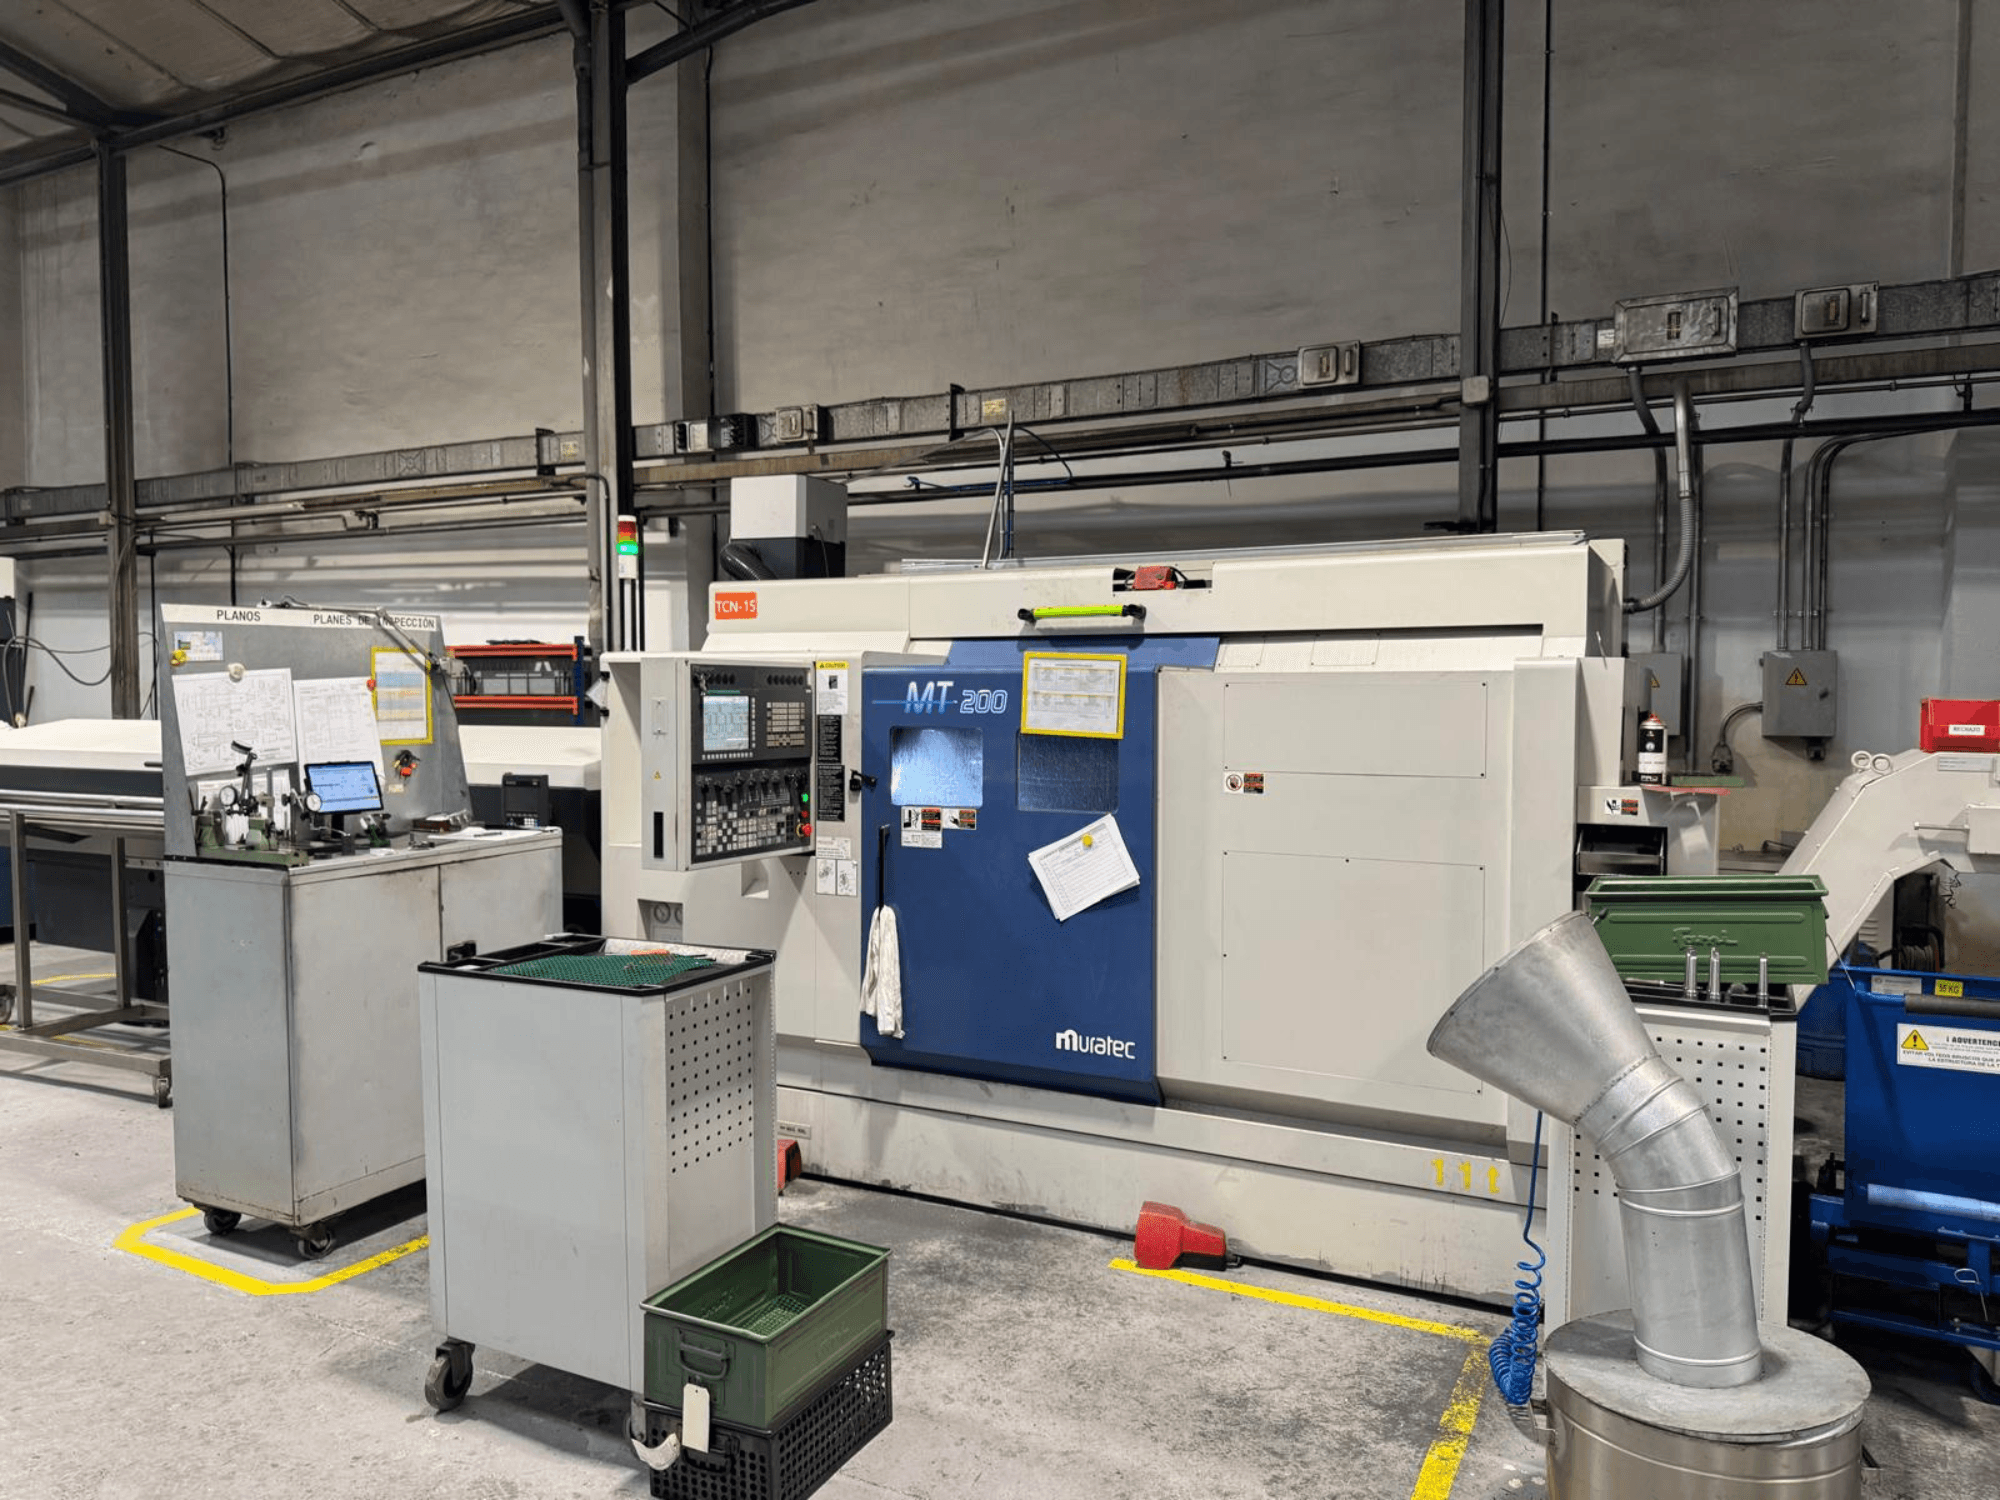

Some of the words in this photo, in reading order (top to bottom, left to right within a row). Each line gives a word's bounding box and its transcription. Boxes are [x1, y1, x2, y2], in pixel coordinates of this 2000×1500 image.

[216, 610, 261, 622] PLANOS
[313, 614, 352, 626] PLANES
[358, 615, 370, 626] DE
[904, 681, 955, 714] MT
[960, 689, 1008, 714] 200
